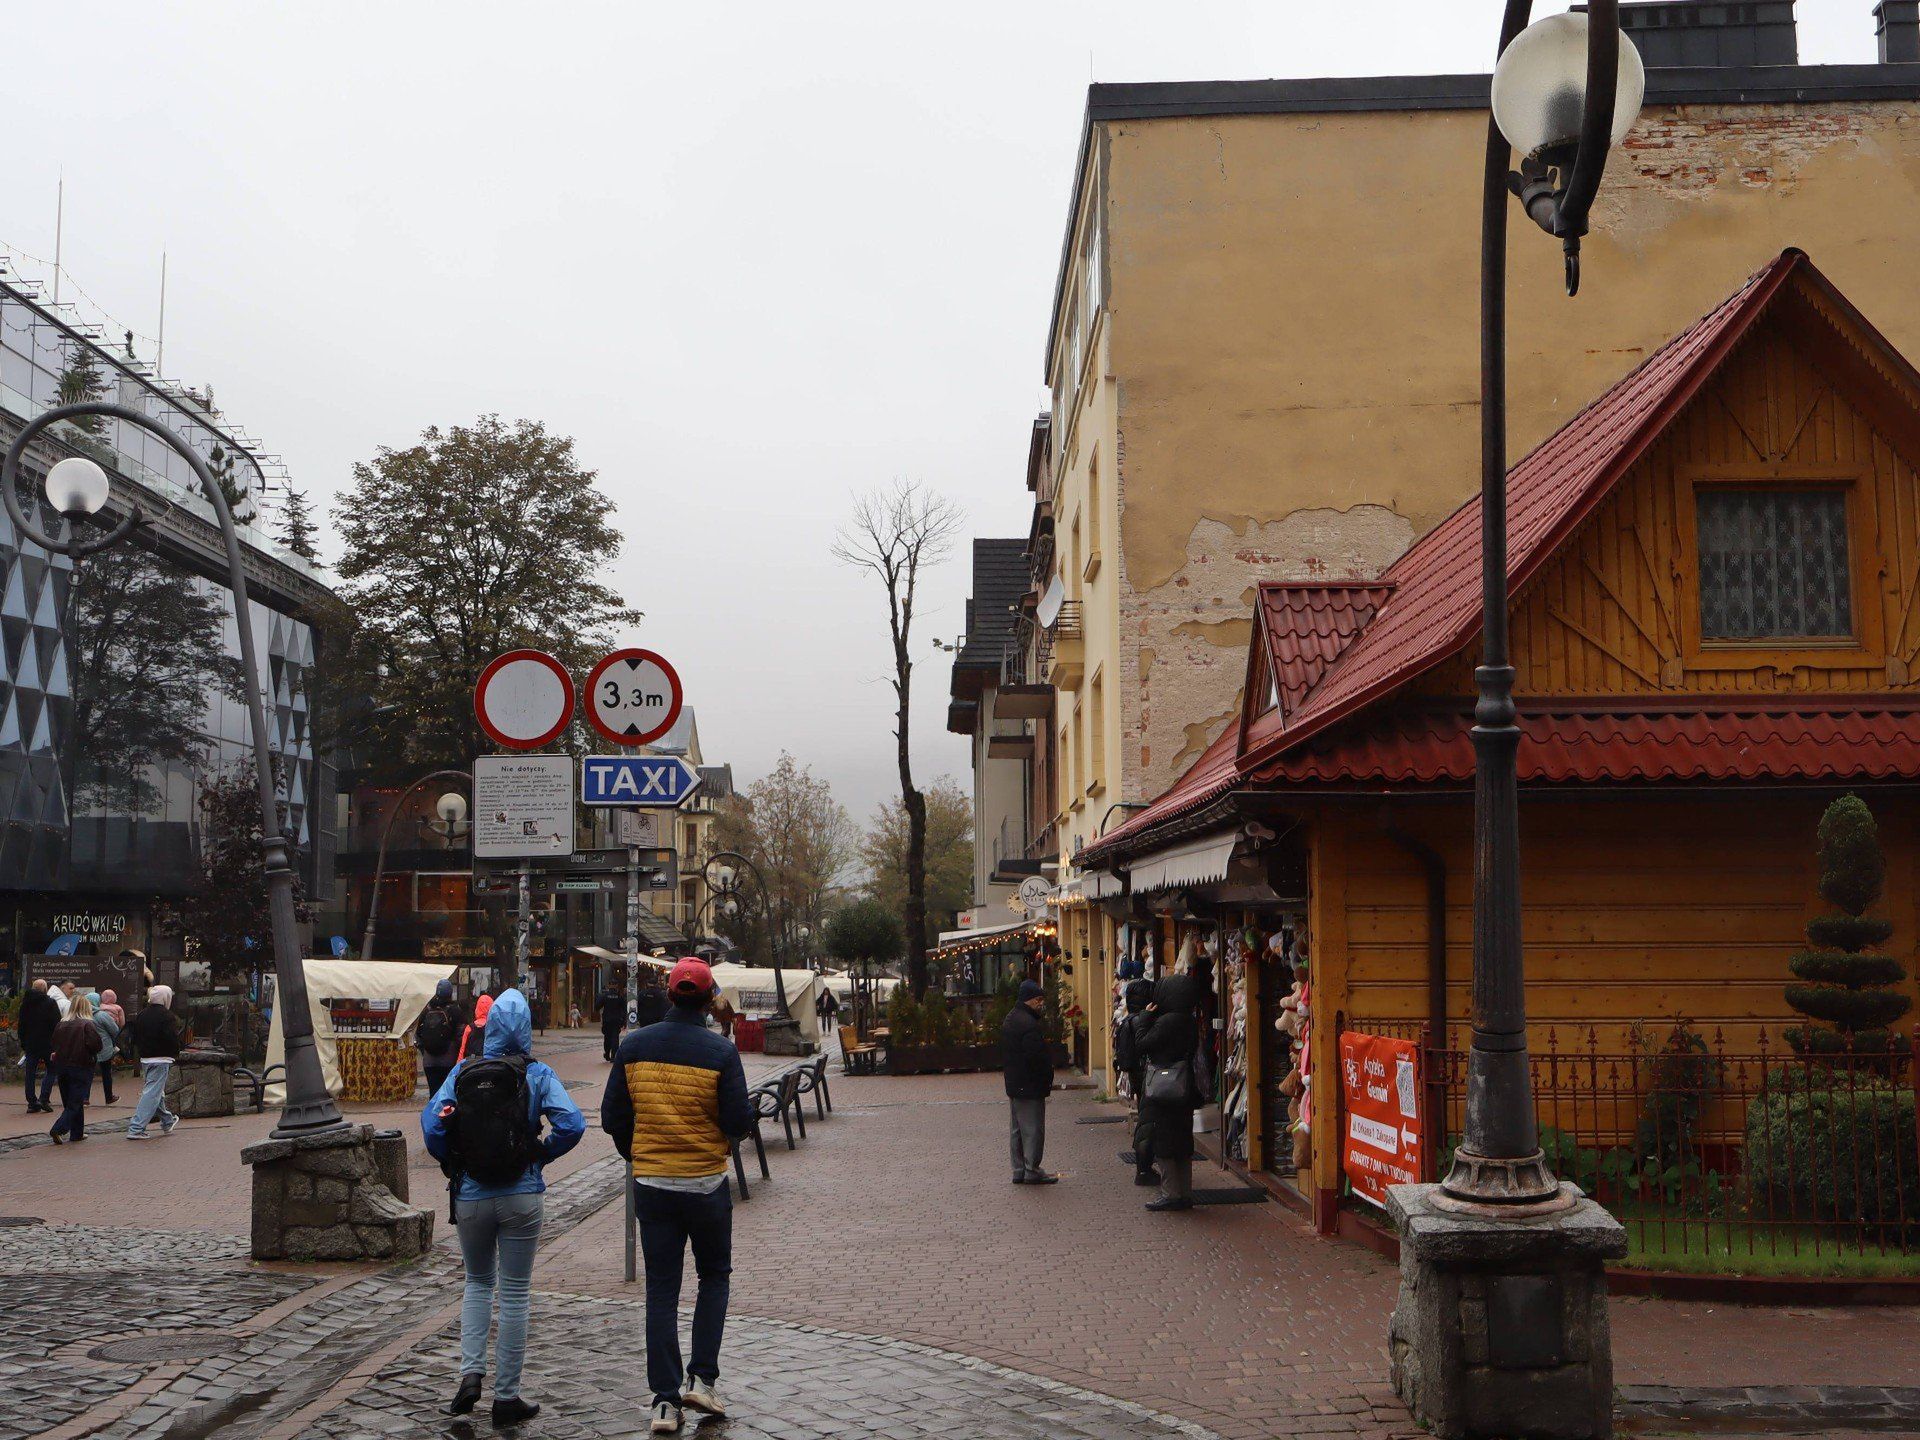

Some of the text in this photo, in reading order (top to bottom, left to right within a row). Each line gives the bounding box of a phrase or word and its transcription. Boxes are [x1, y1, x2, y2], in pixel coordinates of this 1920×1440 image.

[590, 766, 677, 796] TAXI
[53, 910, 110, 933] KRUPÓWKI
[1363, 1056, 1386, 1079] Apteka
